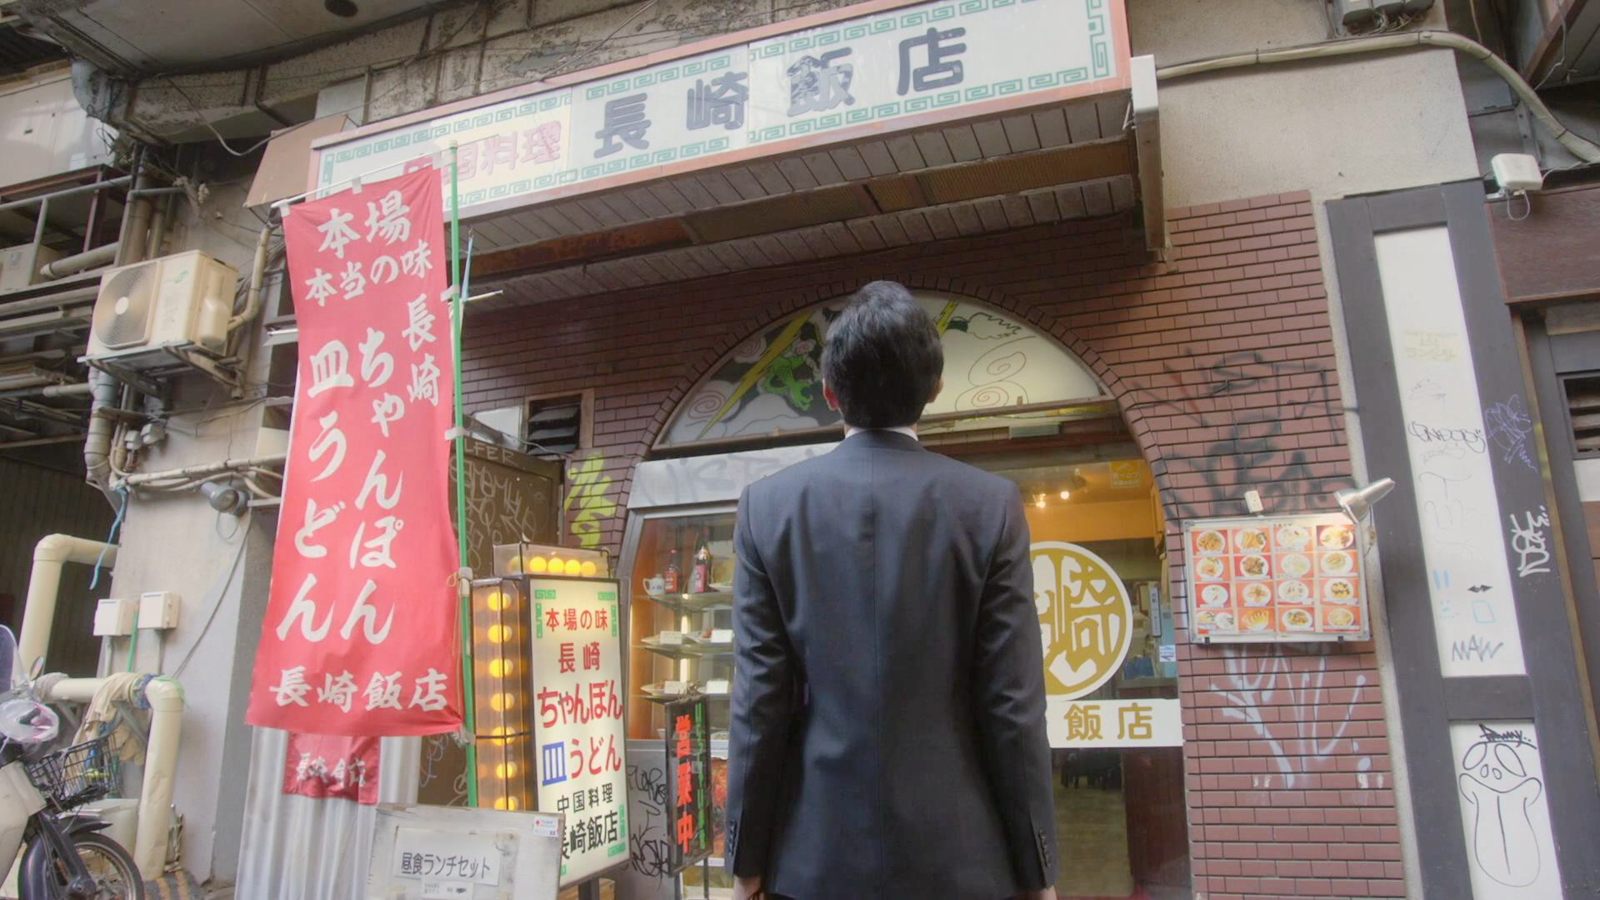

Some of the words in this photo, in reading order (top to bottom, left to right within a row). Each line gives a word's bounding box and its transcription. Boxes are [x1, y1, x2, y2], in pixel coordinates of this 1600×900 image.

[593, 26, 967, 158] 長崎飯店
[317, 190, 411, 259] 本場
[305, 239, 433, 307] 本当の味
[402, 293, 441, 407] 長崎
[276, 339, 355, 642] 皿うどん
[545, 608, 608, 632] 本場の味
[558, 641, 601, 674] 長崎
[269, 666, 448, 713] 長崎飯店
[537, 680, 625, 729] ちゃんぽん
[1064, 702, 1153, 741] 飯店
[542, 733, 622, 786] 皿うどん
[557, 782, 613, 814] 中国料理
[401, 852, 491, 880] 昼食ランチセット
